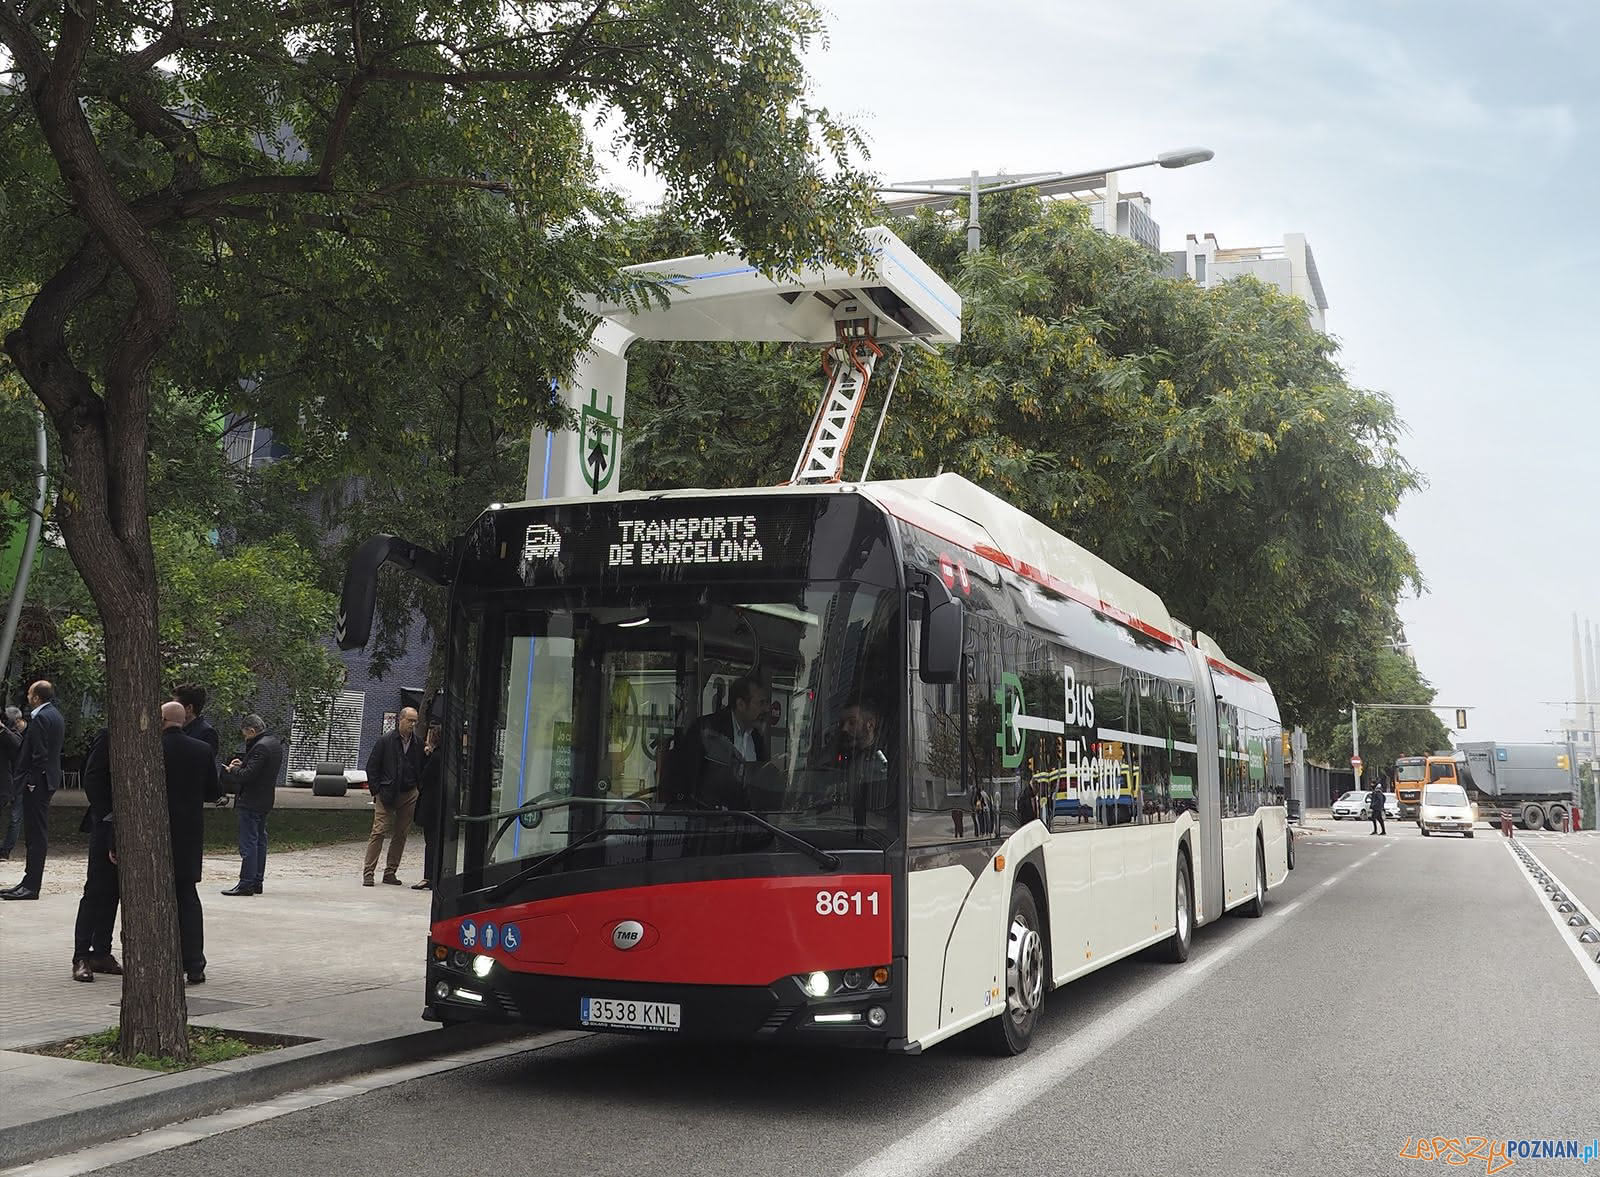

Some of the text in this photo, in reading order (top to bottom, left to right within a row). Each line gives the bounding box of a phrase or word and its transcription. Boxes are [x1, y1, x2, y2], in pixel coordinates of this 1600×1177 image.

[618, 515, 757, 542] TRANSPORTS
[608, 539, 763, 566] DE BARCELONA
[1064, 664, 1095, 729] Bus
[1065, 735, 1122, 801] Elèctric
[815, 890, 879, 916] 8611
[617, 931, 639, 941] TMB
[593, 1001, 637, 1022] 3538
[643, 1004, 677, 1026] KNL
